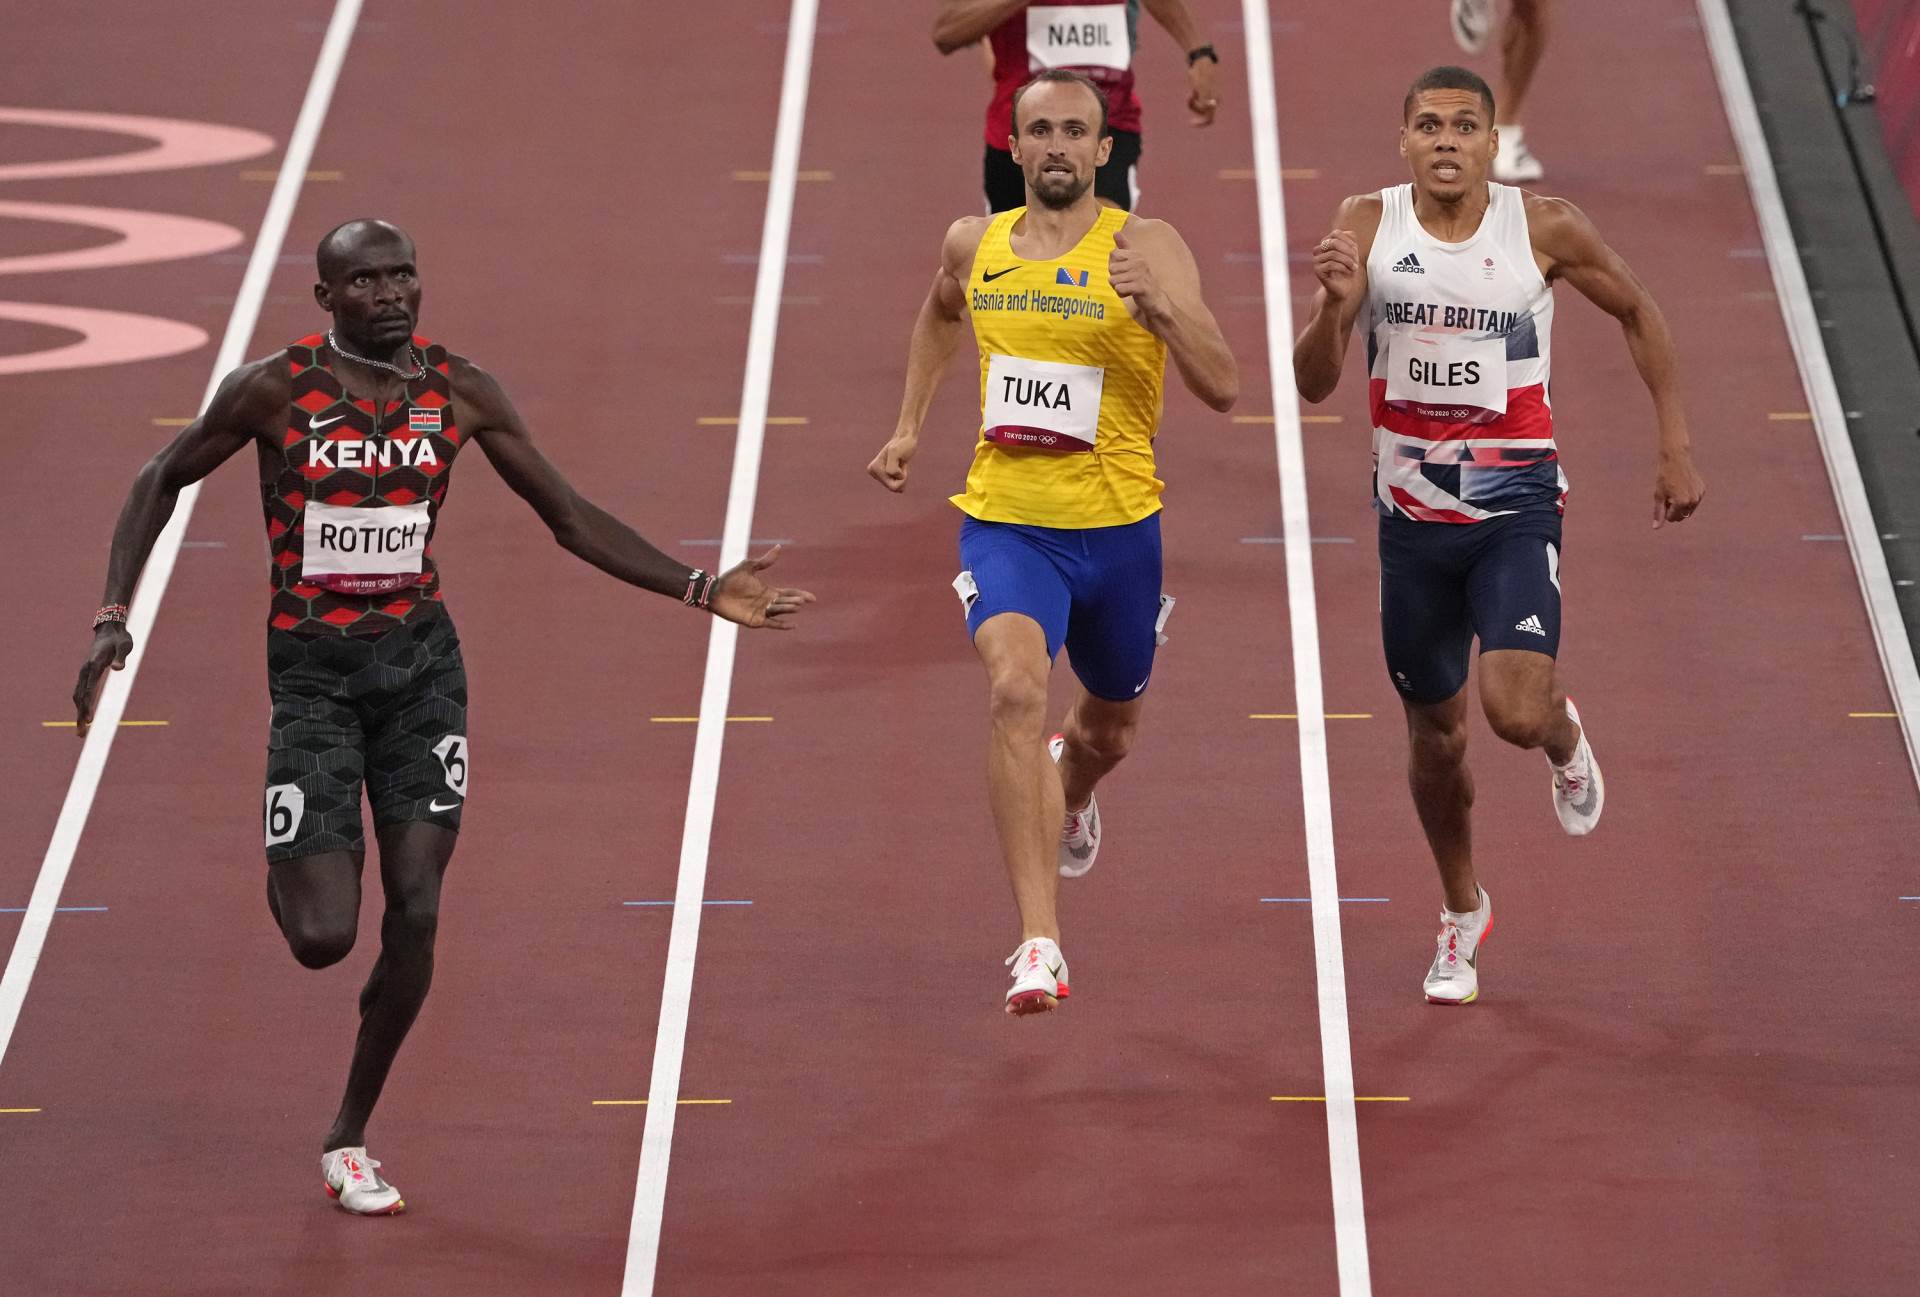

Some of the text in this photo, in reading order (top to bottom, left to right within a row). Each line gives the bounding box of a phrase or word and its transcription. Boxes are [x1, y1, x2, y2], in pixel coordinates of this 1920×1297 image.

[1048, 24, 1111, 46] NABIL
[1392, 264, 1425, 274] adidas
[972, 288, 1104, 320] Bosnia and Herzegovina
[1385, 302, 1518, 333] GREAT BRITAIN
[1409, 357, 1480, 387] GILES
[1003, 376, 1071, 411] TUKA
[1416, 407, 1434, 416] TOKYO
[1004, 431, 1022, 440] TOKYO
[308, 438, 438, 468] KENYA
[320, 522, 417, 553] ROTICH
[360, 580, 376, 588] 2020
[1515, 624, 1546, 637] adidas
[444, 741, 465, 787] 6
[269, 791, 292, 837] 6
